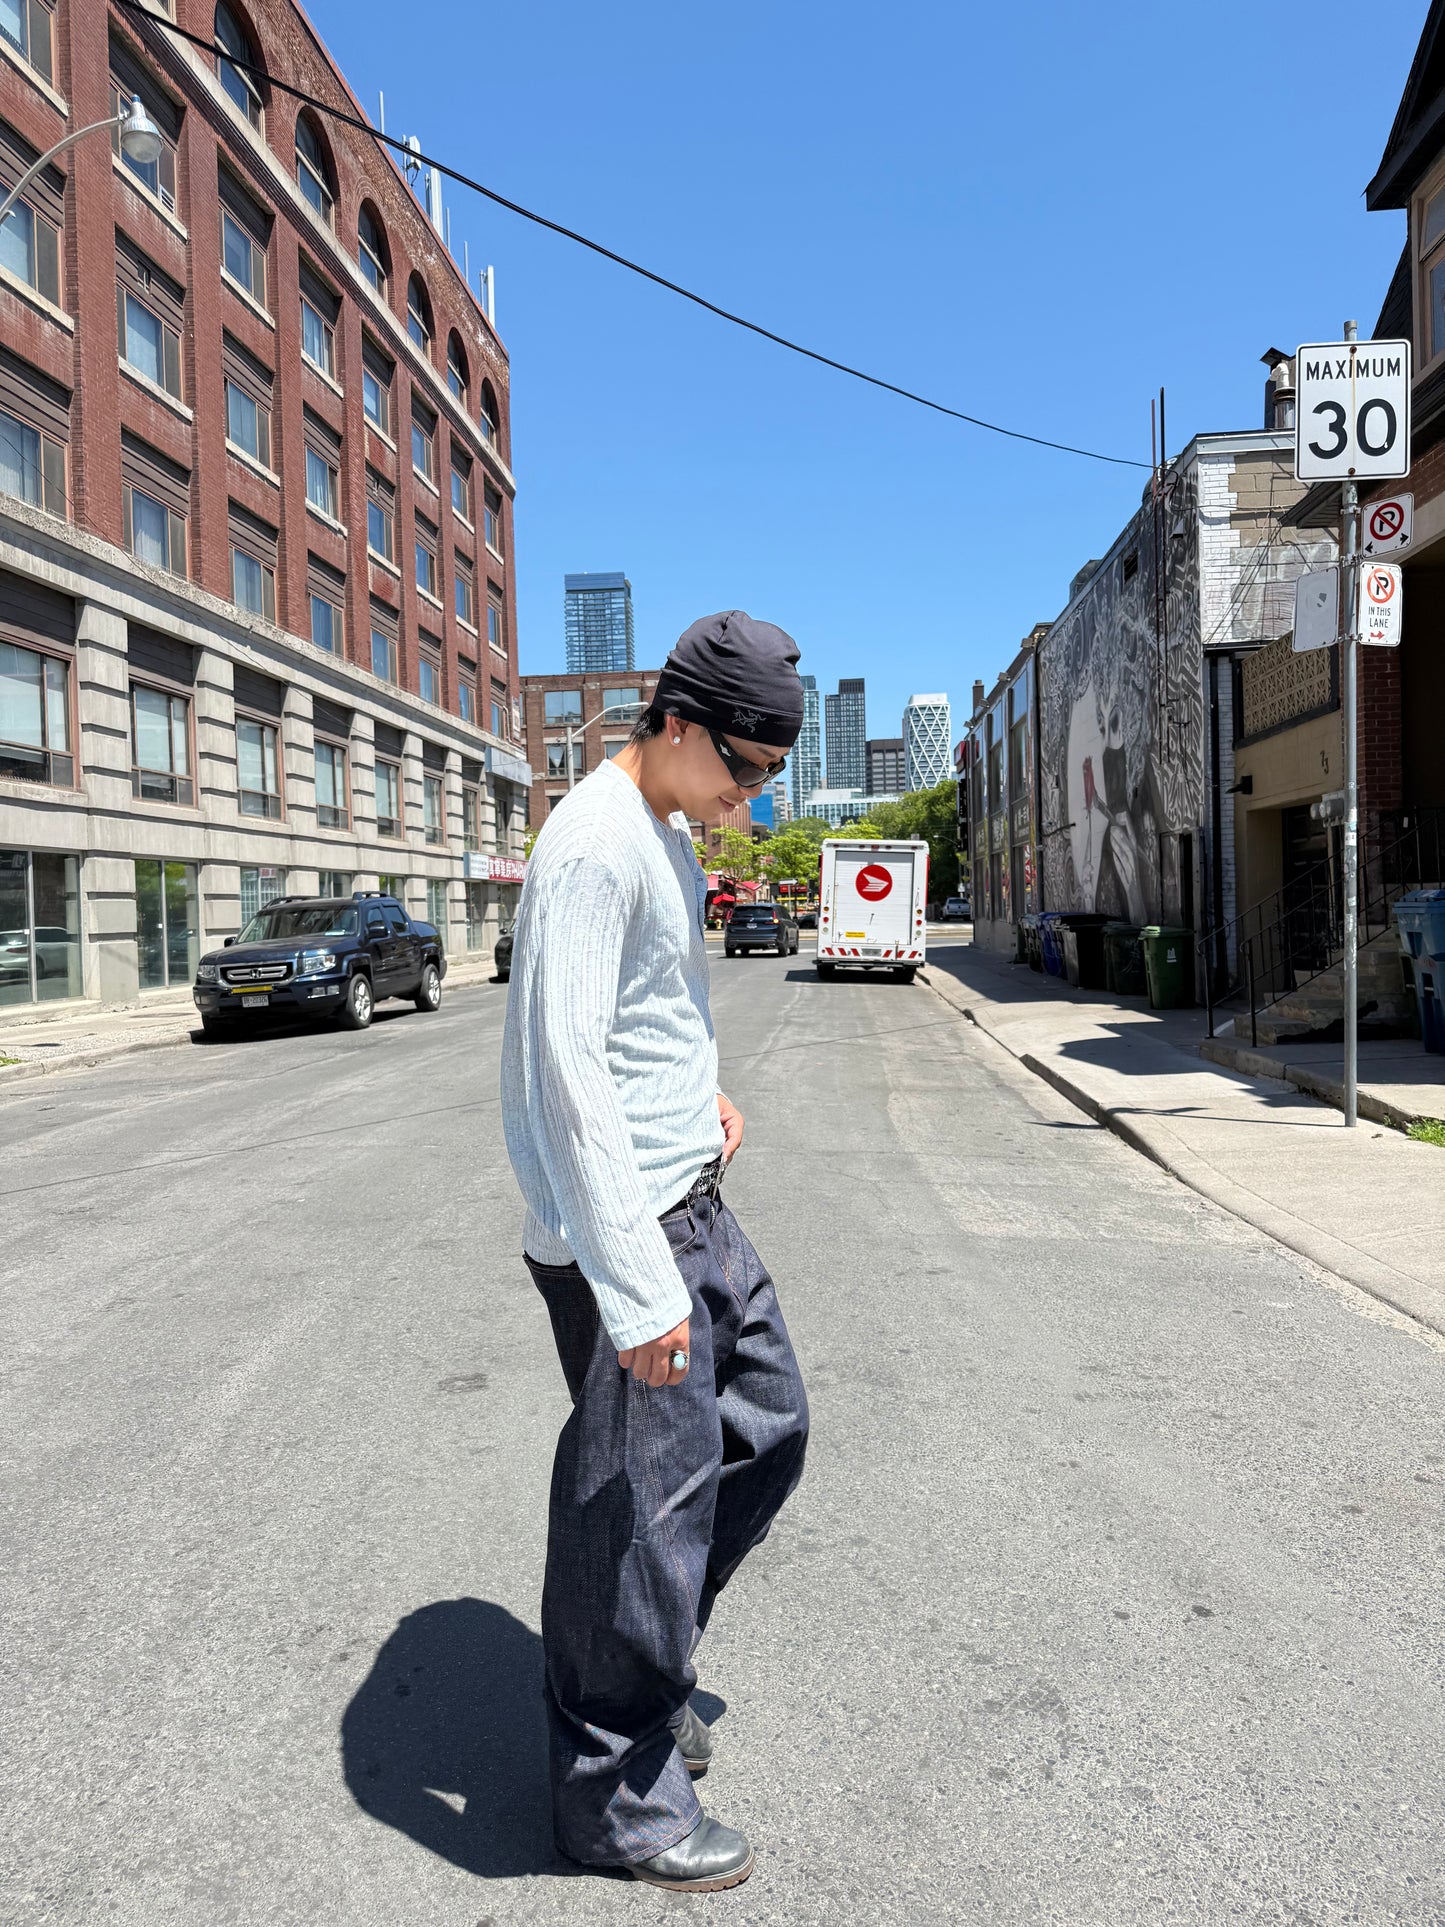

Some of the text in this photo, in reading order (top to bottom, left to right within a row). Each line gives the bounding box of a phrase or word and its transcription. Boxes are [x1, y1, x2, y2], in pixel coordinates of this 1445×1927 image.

[1306, 357, 1401, 381] MAXIMUM
[1308, 398, 1397, 460] 30
[1368, 605, 1391, 617] IN THIS
[1369, 617, 1389, 629] LANE
